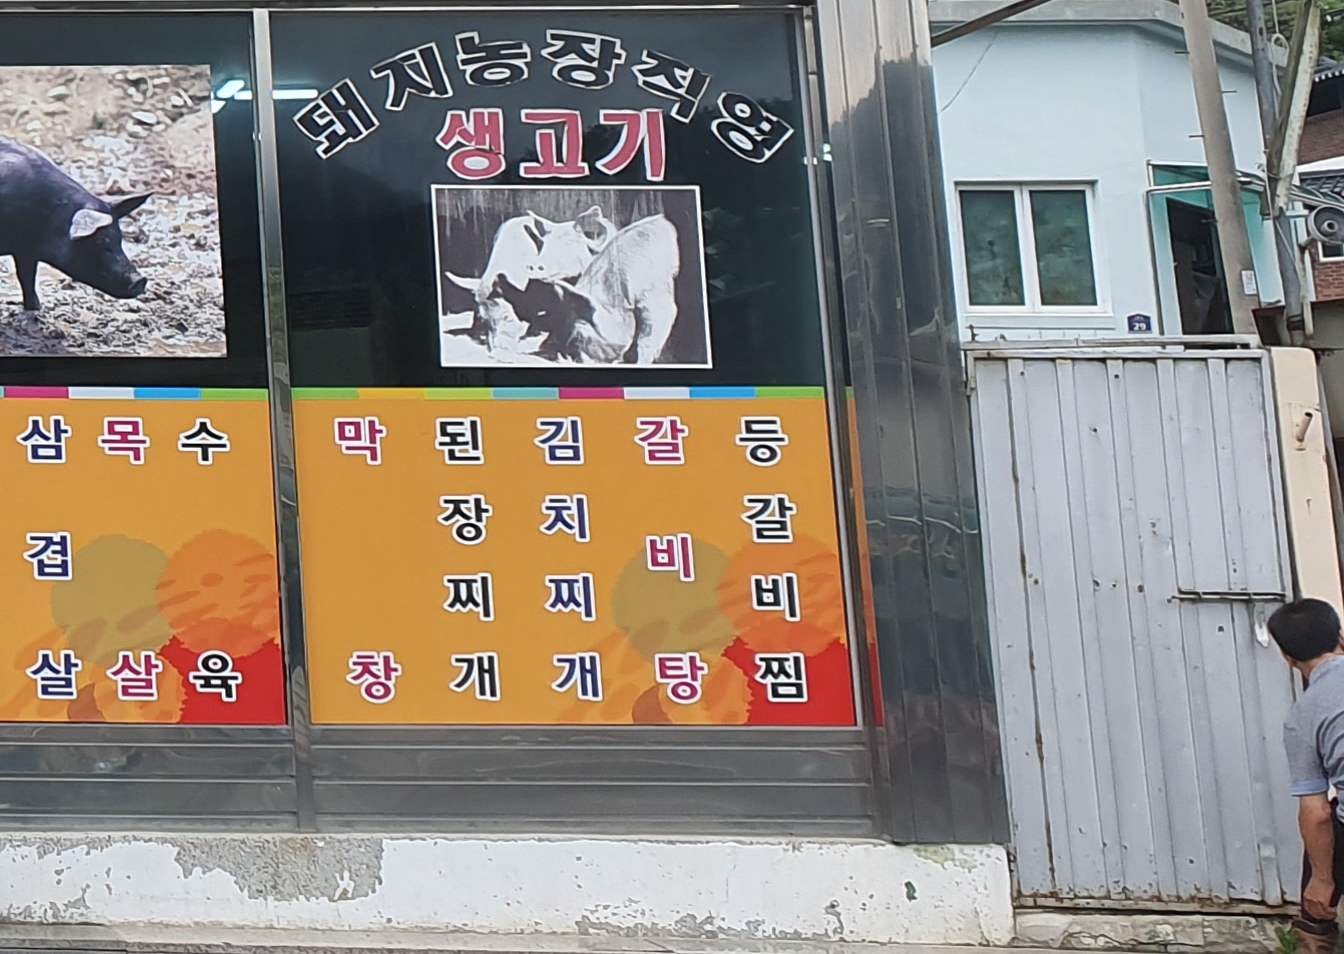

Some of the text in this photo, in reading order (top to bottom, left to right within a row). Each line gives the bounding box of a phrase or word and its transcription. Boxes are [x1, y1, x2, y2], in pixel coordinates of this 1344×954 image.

[293, 30, 795, 164] 돼지농장직영
[435, 107, 666, 182] 생고기
[17, 416, 82, 700] 삼겹살
[435, 417, 502, 701] 된장찌개
[534, 417, 604, 701] 김치찌개
[634, 417, 708, 703] 갈비탕
[736, 417, 808, 702] 등갈비찜
